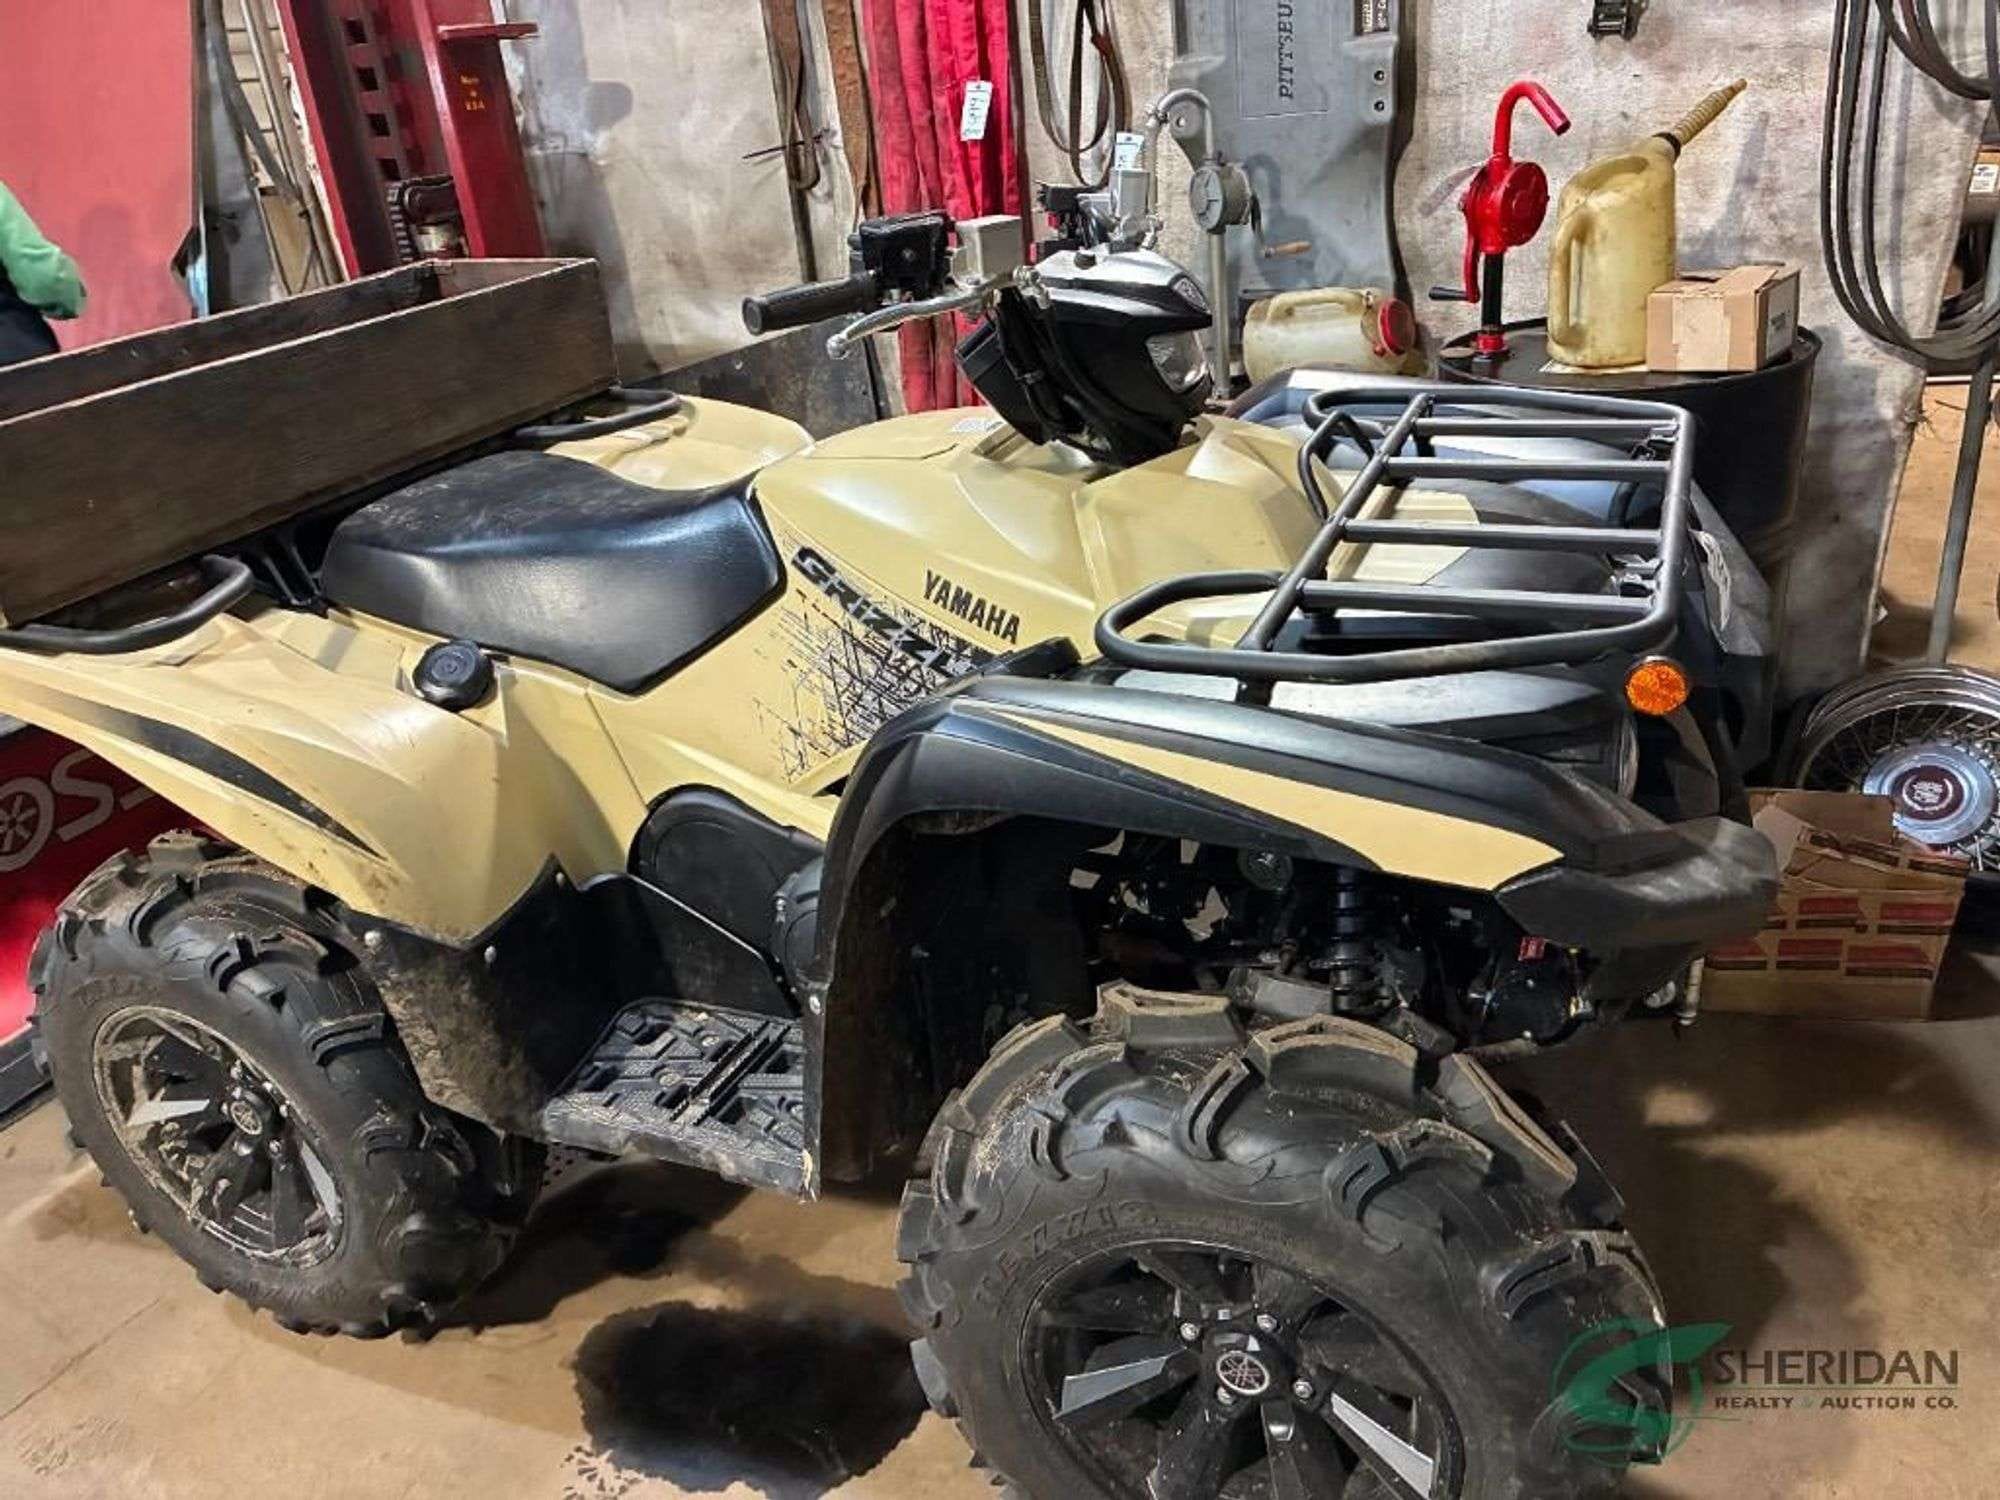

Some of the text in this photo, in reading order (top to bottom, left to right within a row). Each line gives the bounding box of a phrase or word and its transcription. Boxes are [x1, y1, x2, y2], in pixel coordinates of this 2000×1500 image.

[1278, 0, 1294, 99] PITTSBU
[791, 546, 958, 679] GRIZZL
[922, 569, 1021, 645] YAMAHA
